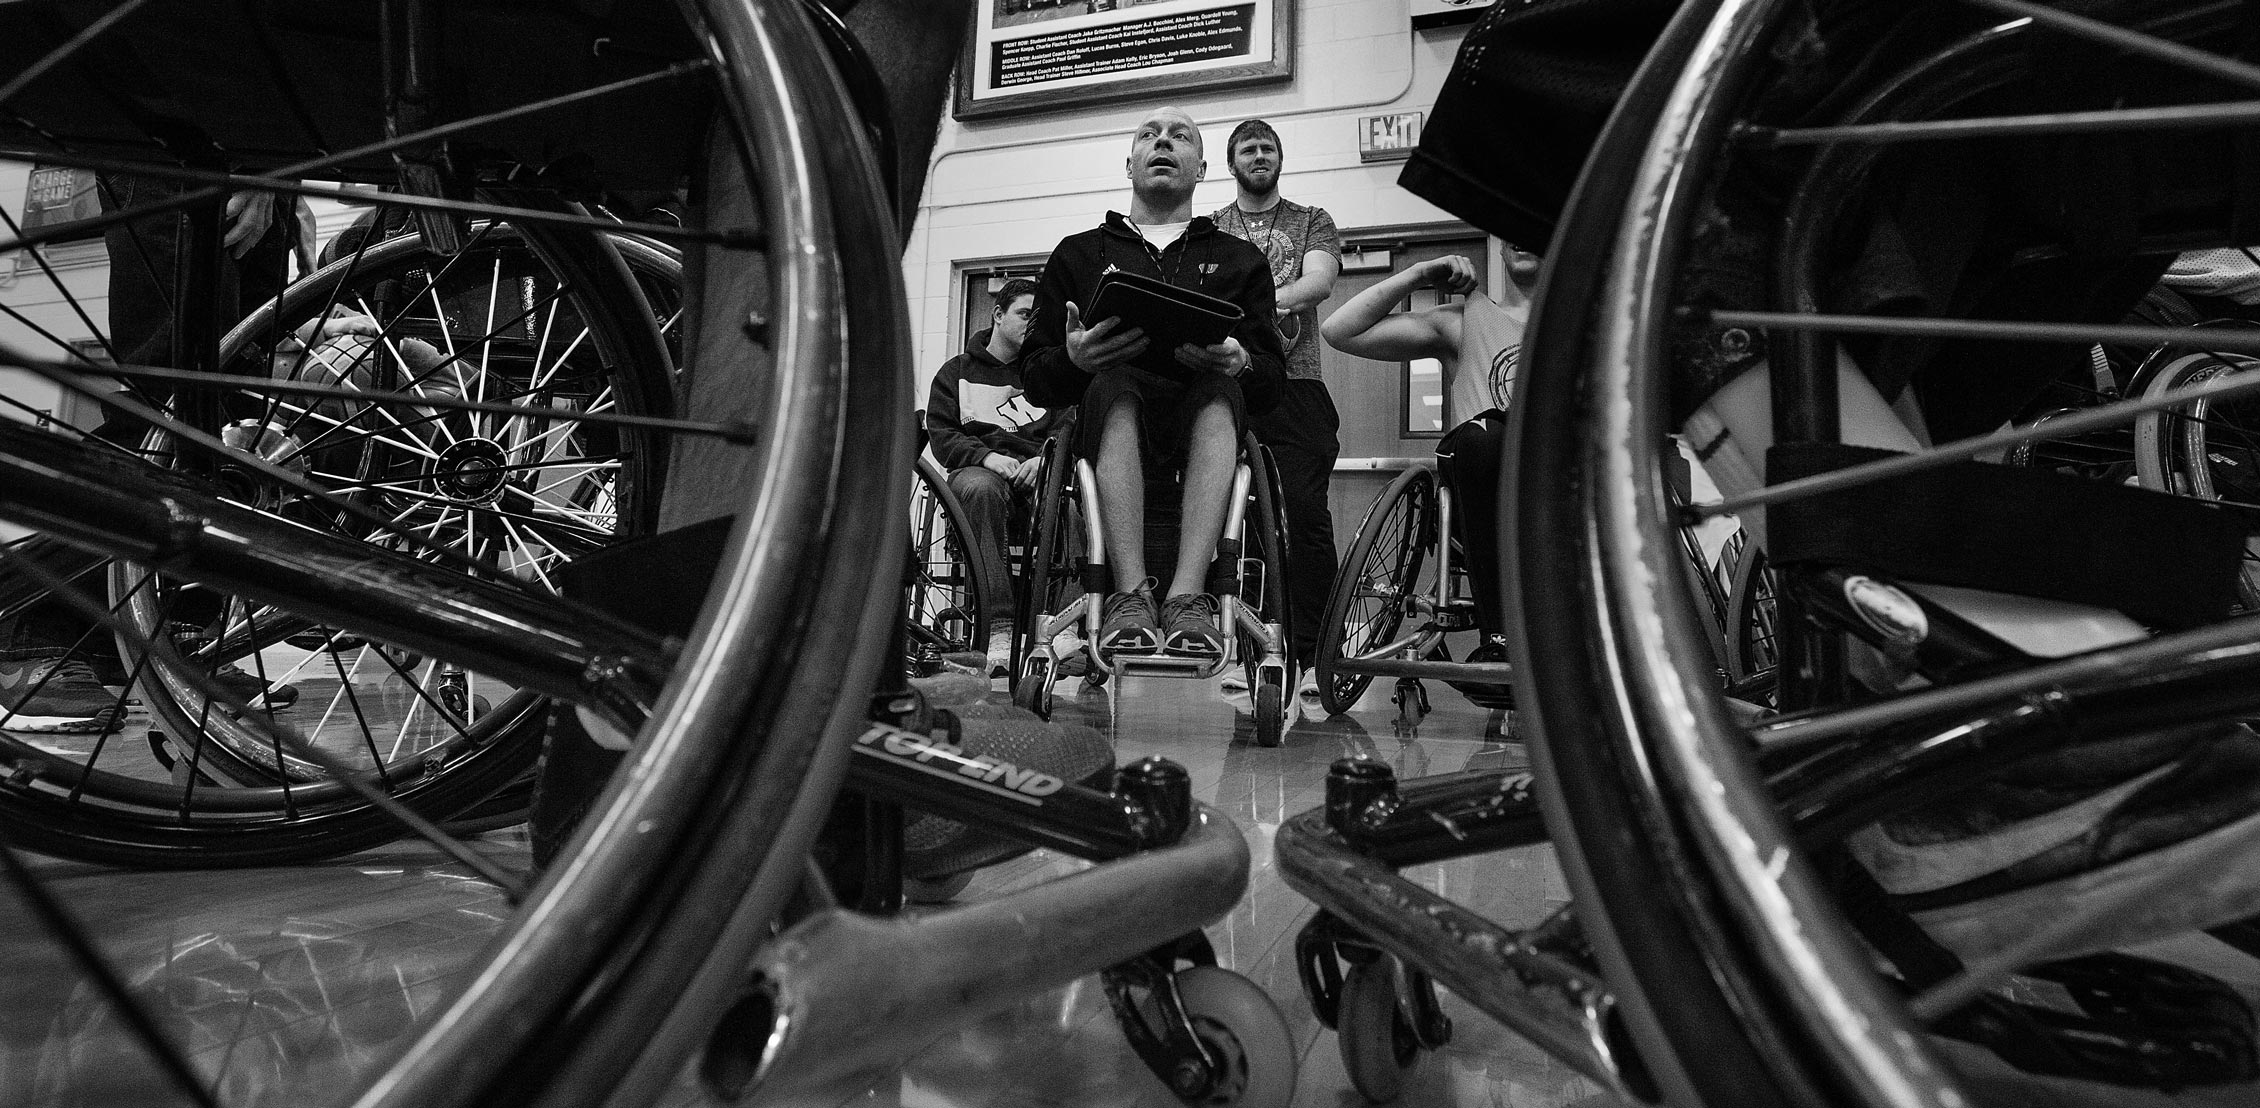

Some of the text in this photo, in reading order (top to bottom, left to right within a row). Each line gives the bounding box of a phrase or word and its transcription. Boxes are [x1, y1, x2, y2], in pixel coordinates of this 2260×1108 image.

[1003, 47, 1020, 55] Spencer
[1156, 25, 1177, 33] Assistant
[1205, 18, 1220, 26] Luther
[1047, 34, 1067, 42] Assistant
[1123, 23, 1143, 31] Manager
[1032, 52, 1051, 60] Assistant
[1002, 62, 1021, 70] Graduate
[1074, 62, 1095, 70] Assistant
[1370, 116, 1412, 149] EXIT
[33, 169, 73, 190] CHARGE
[43, 185, 70, 201] GAME
[857, 721, 1064, 796] TOP END
